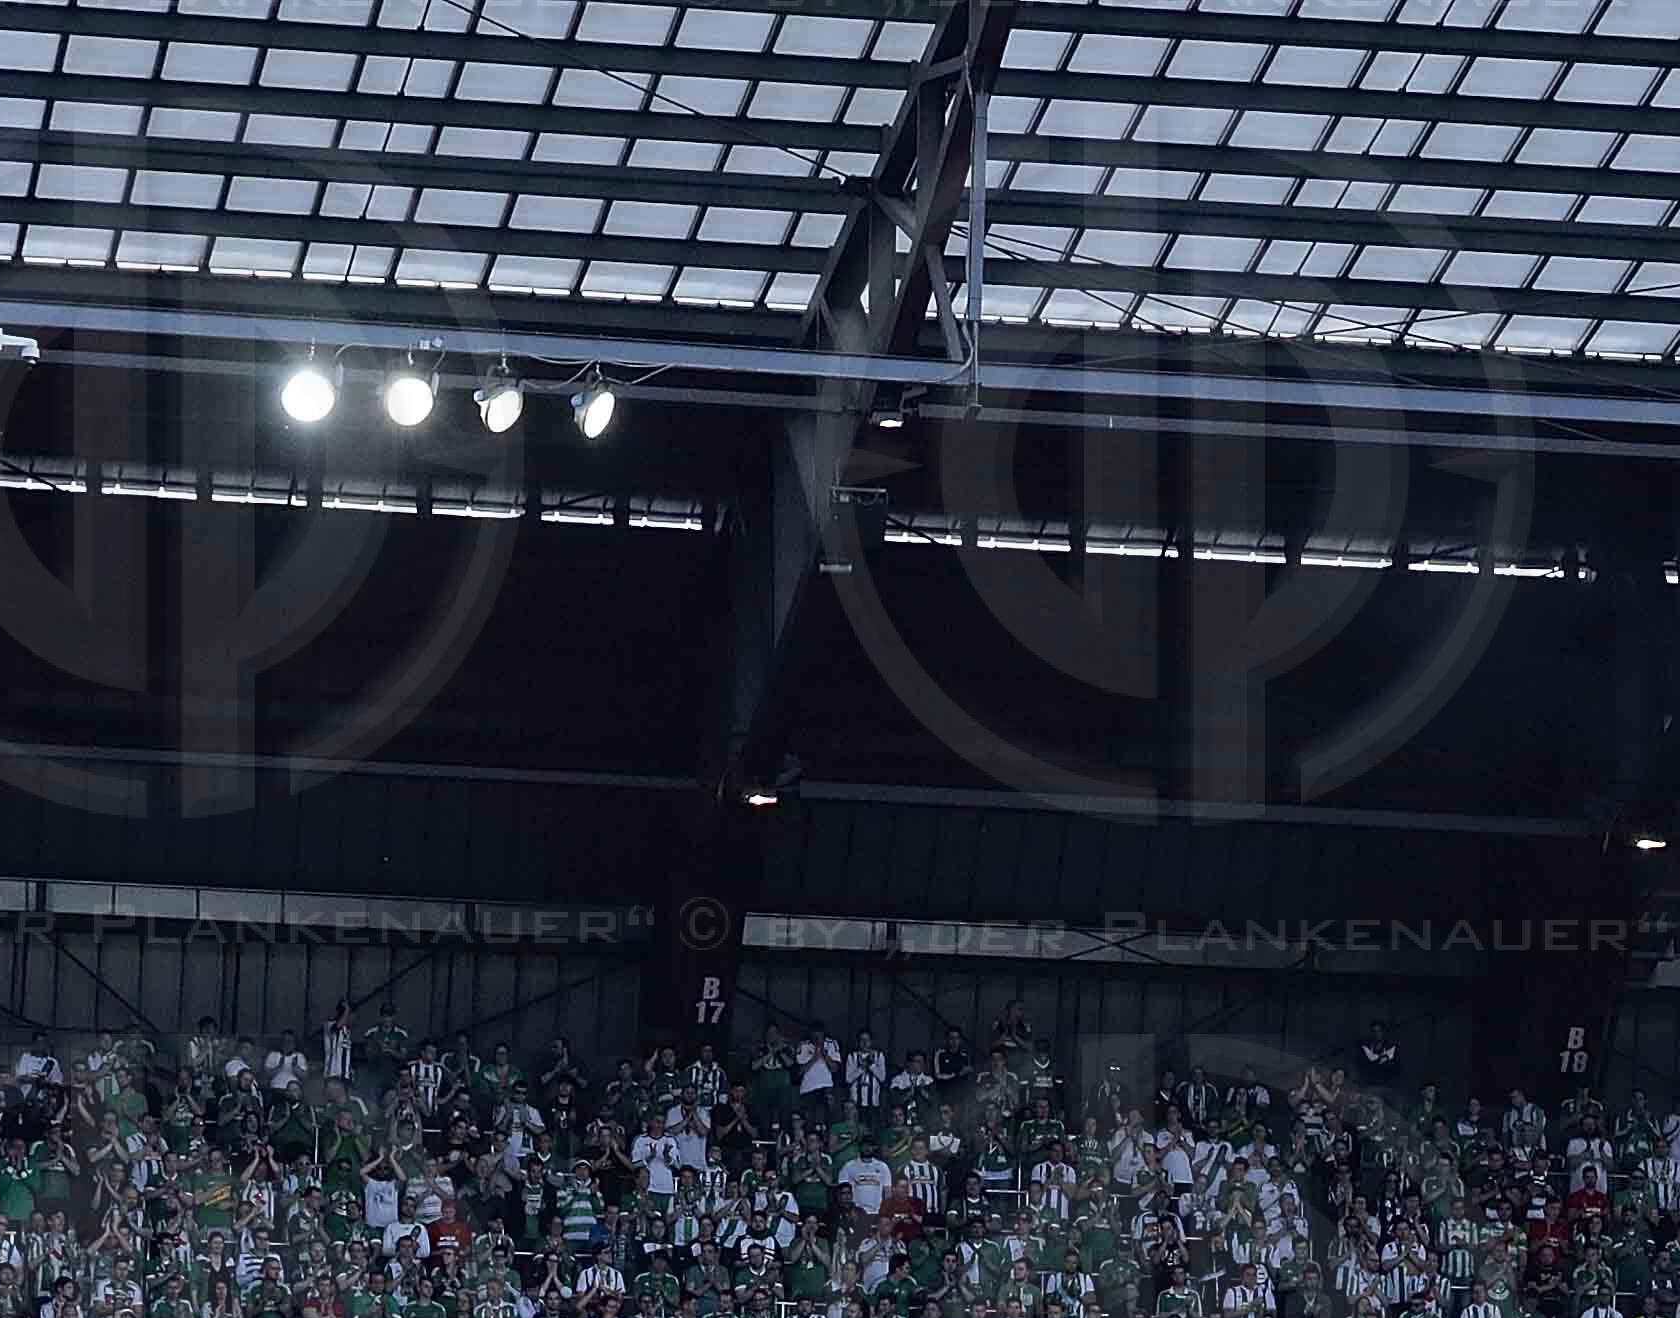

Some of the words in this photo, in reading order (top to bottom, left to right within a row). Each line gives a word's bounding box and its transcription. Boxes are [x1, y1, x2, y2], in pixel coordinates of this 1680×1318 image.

[703, 977, 720, 1000] B
[696, 1001, 724, 1024] 17
[1567, 1027, 1585, 1050] B
[1560, 1051, 1587, 1073] 18
